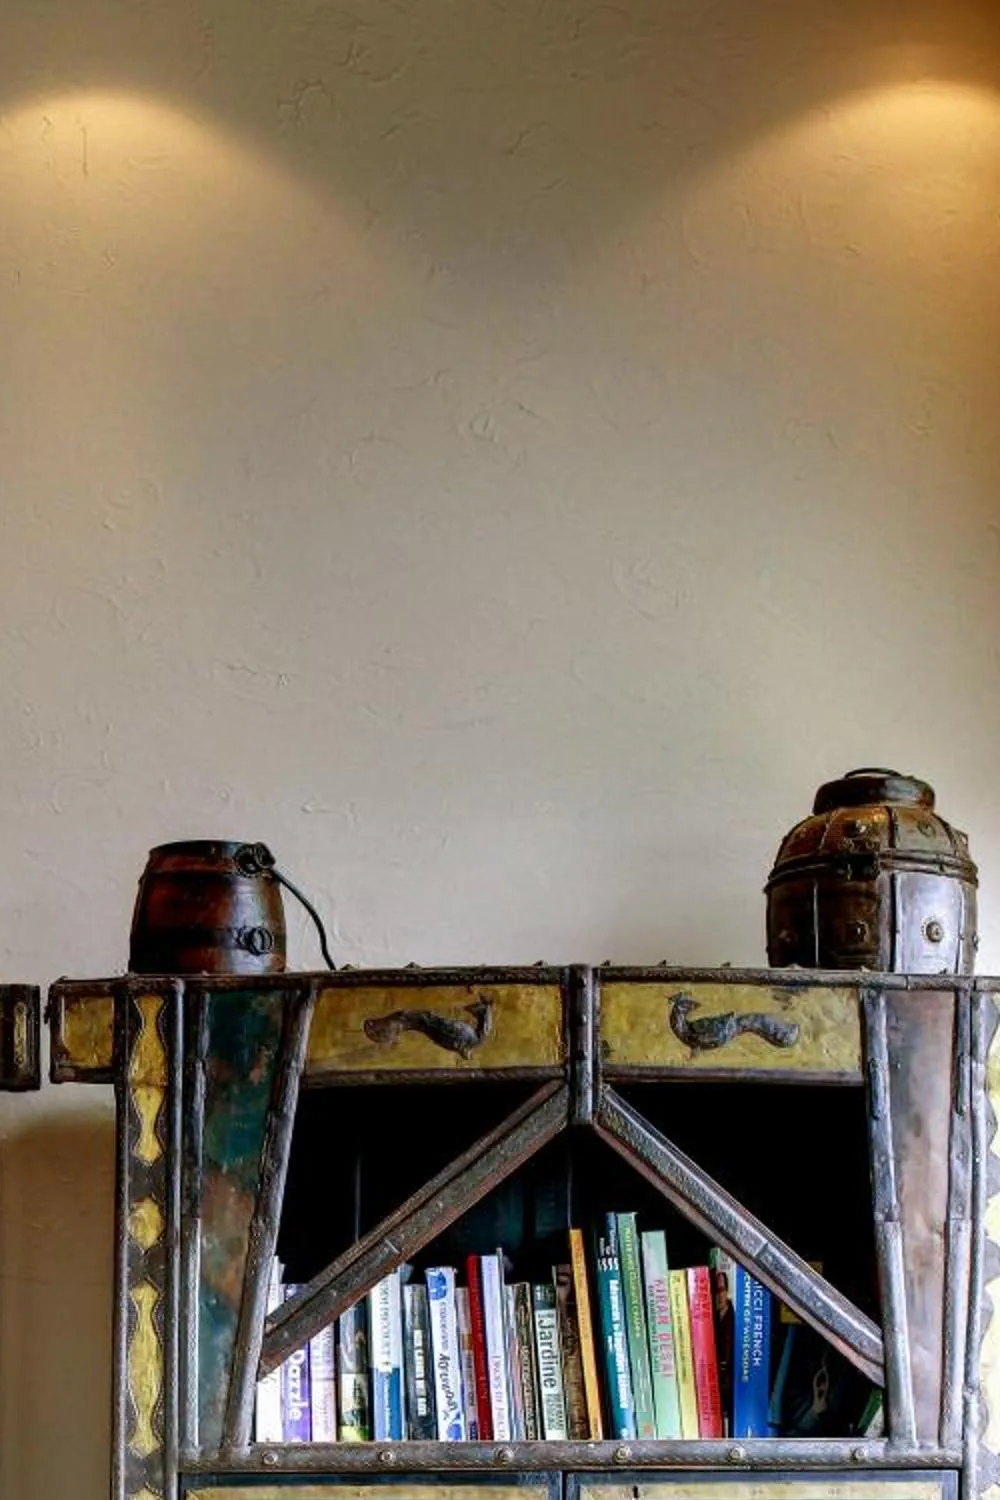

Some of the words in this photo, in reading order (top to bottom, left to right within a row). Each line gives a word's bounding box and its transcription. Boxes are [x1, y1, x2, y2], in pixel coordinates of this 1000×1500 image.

[538, 1318, 560, 1388] Jardine
[751, 1315, 764, 1366] FRENCH
[288, 1350, 308, 1421] Dazzle
